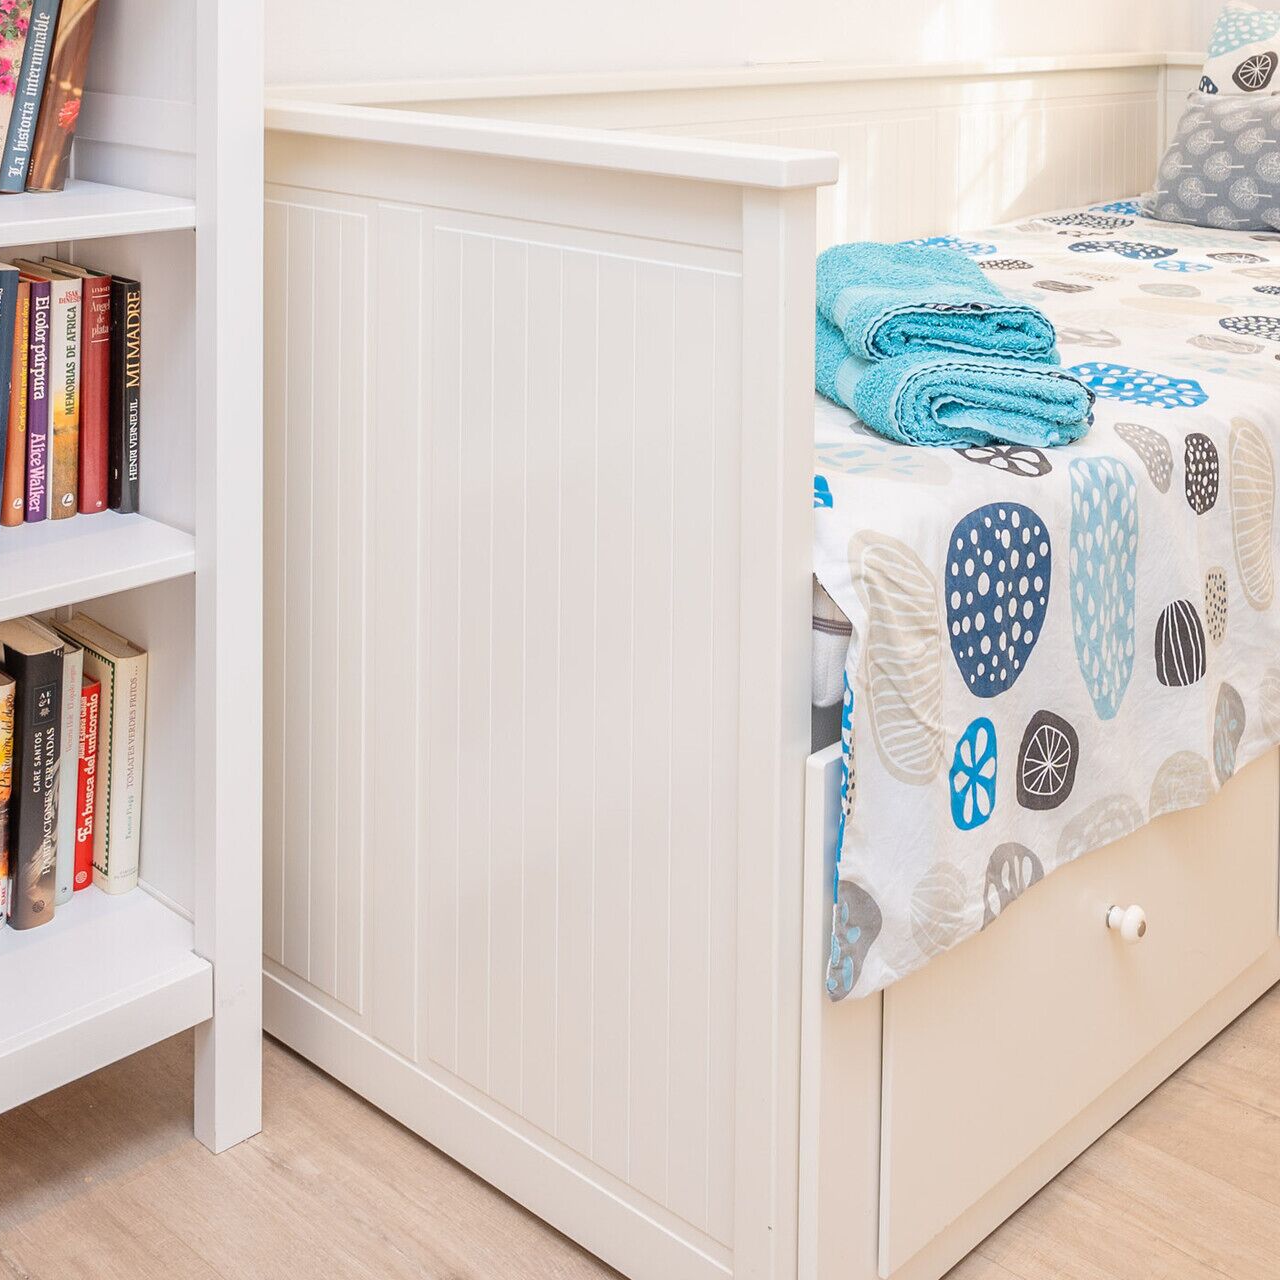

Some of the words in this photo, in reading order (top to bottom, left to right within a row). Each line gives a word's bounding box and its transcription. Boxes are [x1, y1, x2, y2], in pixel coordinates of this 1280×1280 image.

[8, 157, 25, 178] La
[127, 291, 141, 359] MADRE
[127, 363, 140, 387] MI
[129, 398, 138, 446] VERNEUIL
[129, 450, 138, 481] HENRI
[34, 732, 42, 768] SANTOS
[33, 769, 41, 793] CARE
